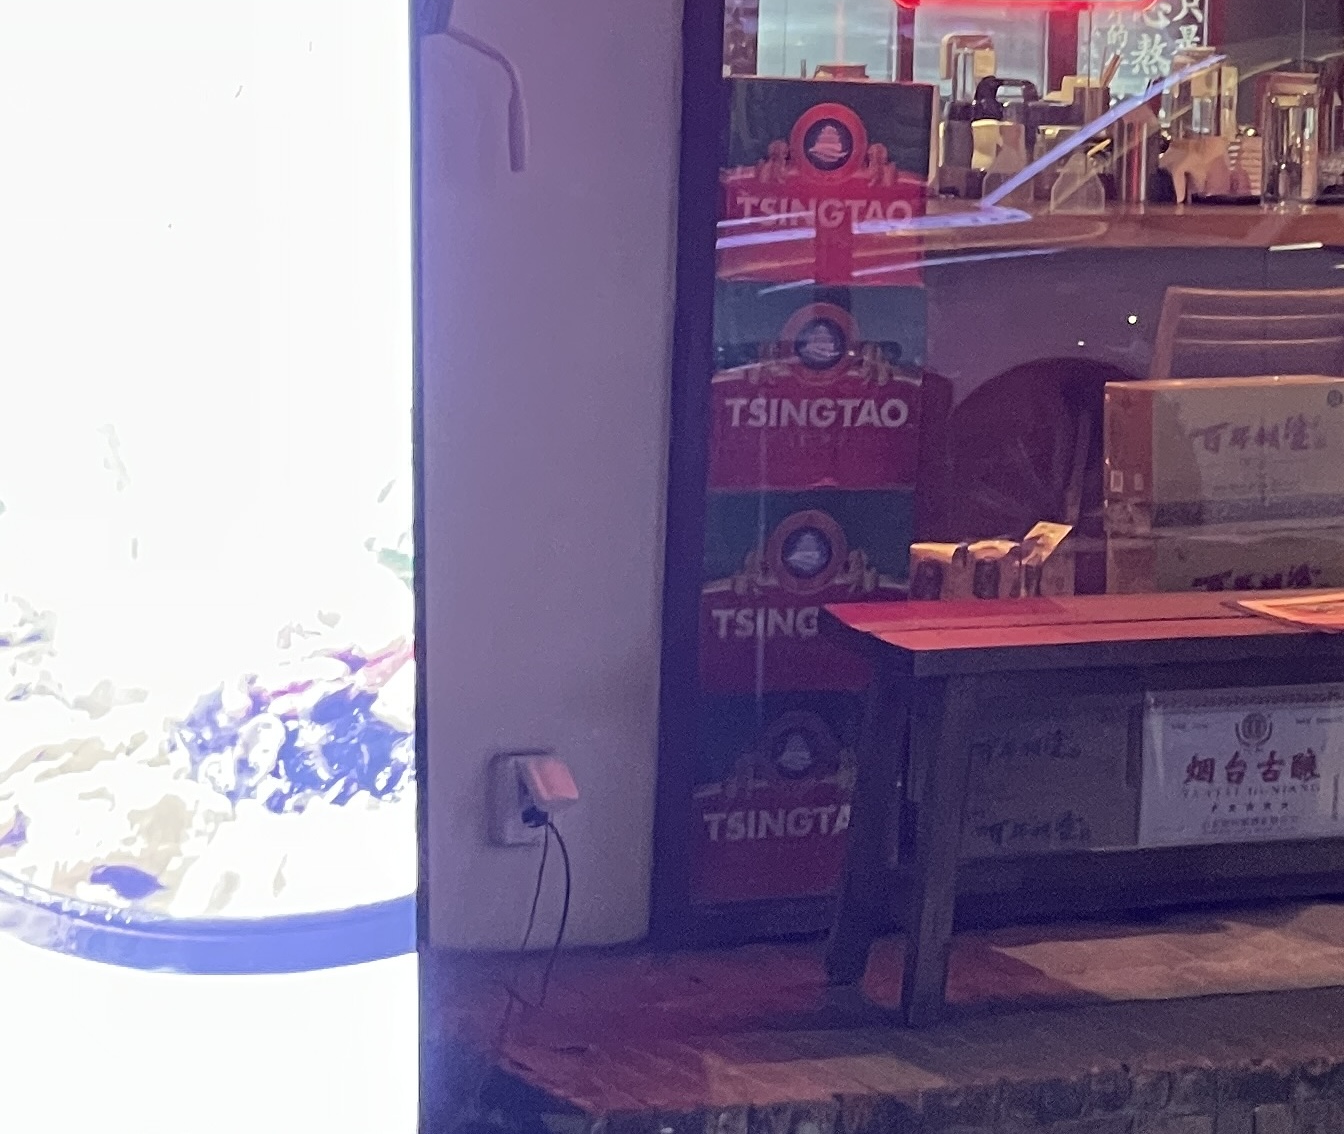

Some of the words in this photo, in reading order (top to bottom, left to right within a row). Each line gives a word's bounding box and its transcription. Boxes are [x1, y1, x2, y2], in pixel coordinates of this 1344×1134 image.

[736, 196, 913, 228] TSINGTAO
[725, 397, 910, 429] TSINGTAO
[711, 605, 820, 640] TSING
[702, 803, 851, 842] TSINGTA
